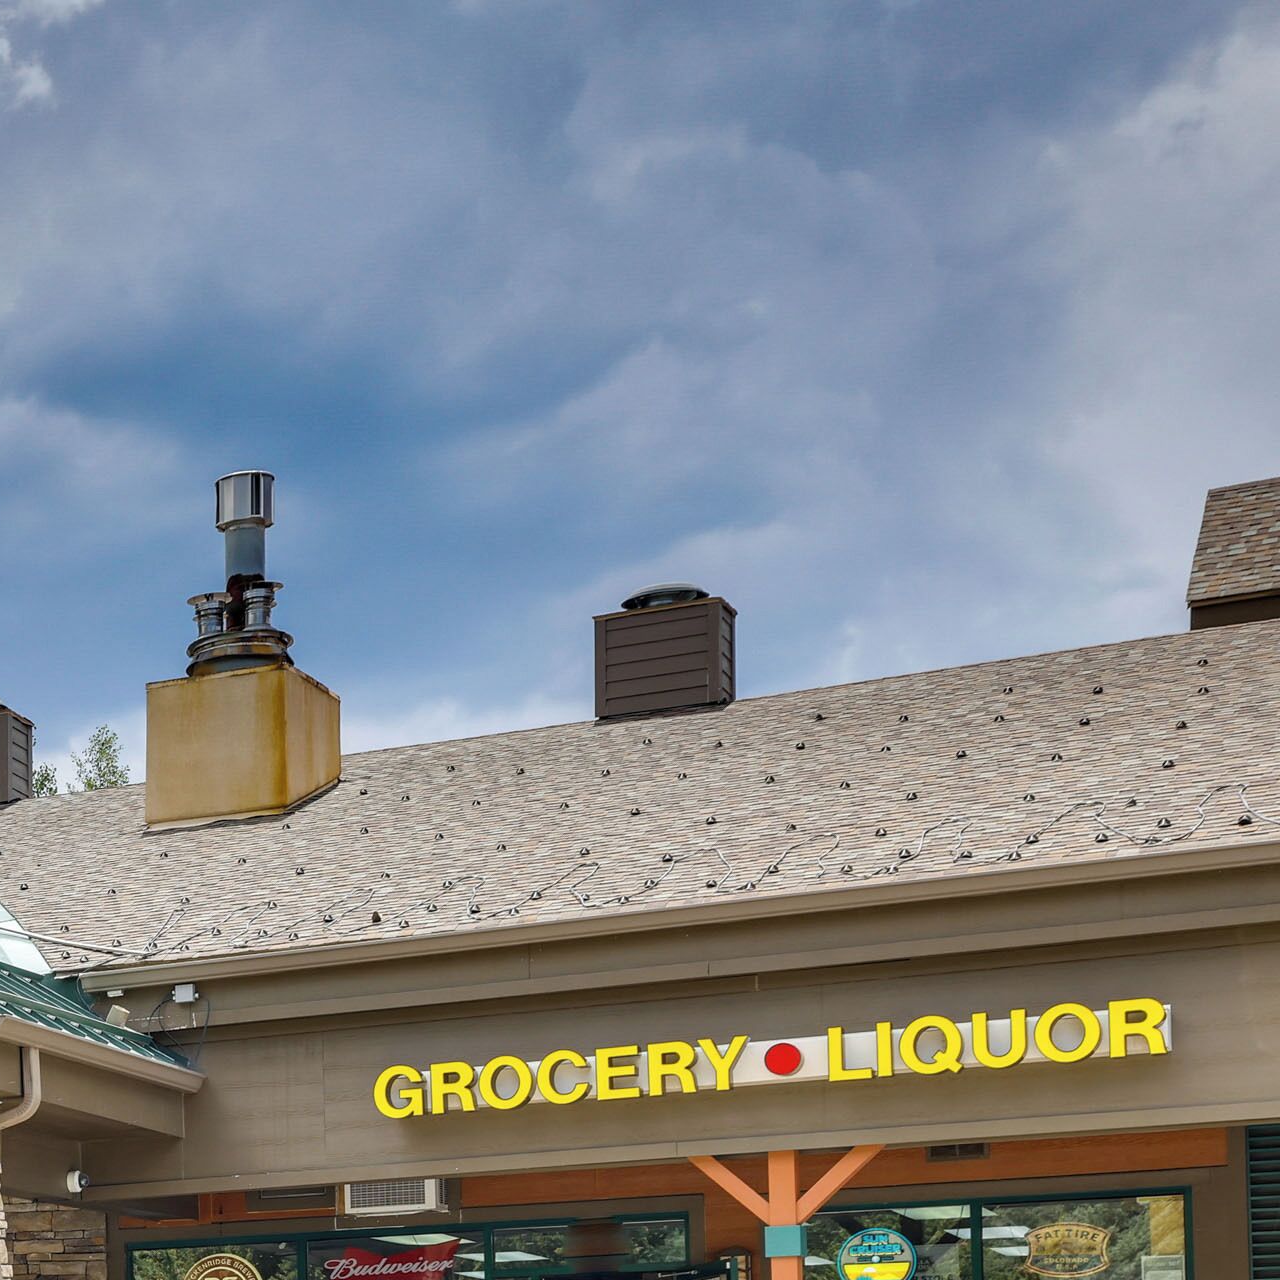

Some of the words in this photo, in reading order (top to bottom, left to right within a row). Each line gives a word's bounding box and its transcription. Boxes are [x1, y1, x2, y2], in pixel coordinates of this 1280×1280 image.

[373, 1036, 749, 1121] GROCERY
[827, 998, 1169, 1083] LIQUOR
[862, 1233, 889, 1245] SUN
[1034, 1230, 1060, 1242] FAT
[1063, 1229, 1100, 1242] TIRE
[848, 1243, 904, 1257] CRUISER
[323, 1256, 454, 1280] Budweiser
